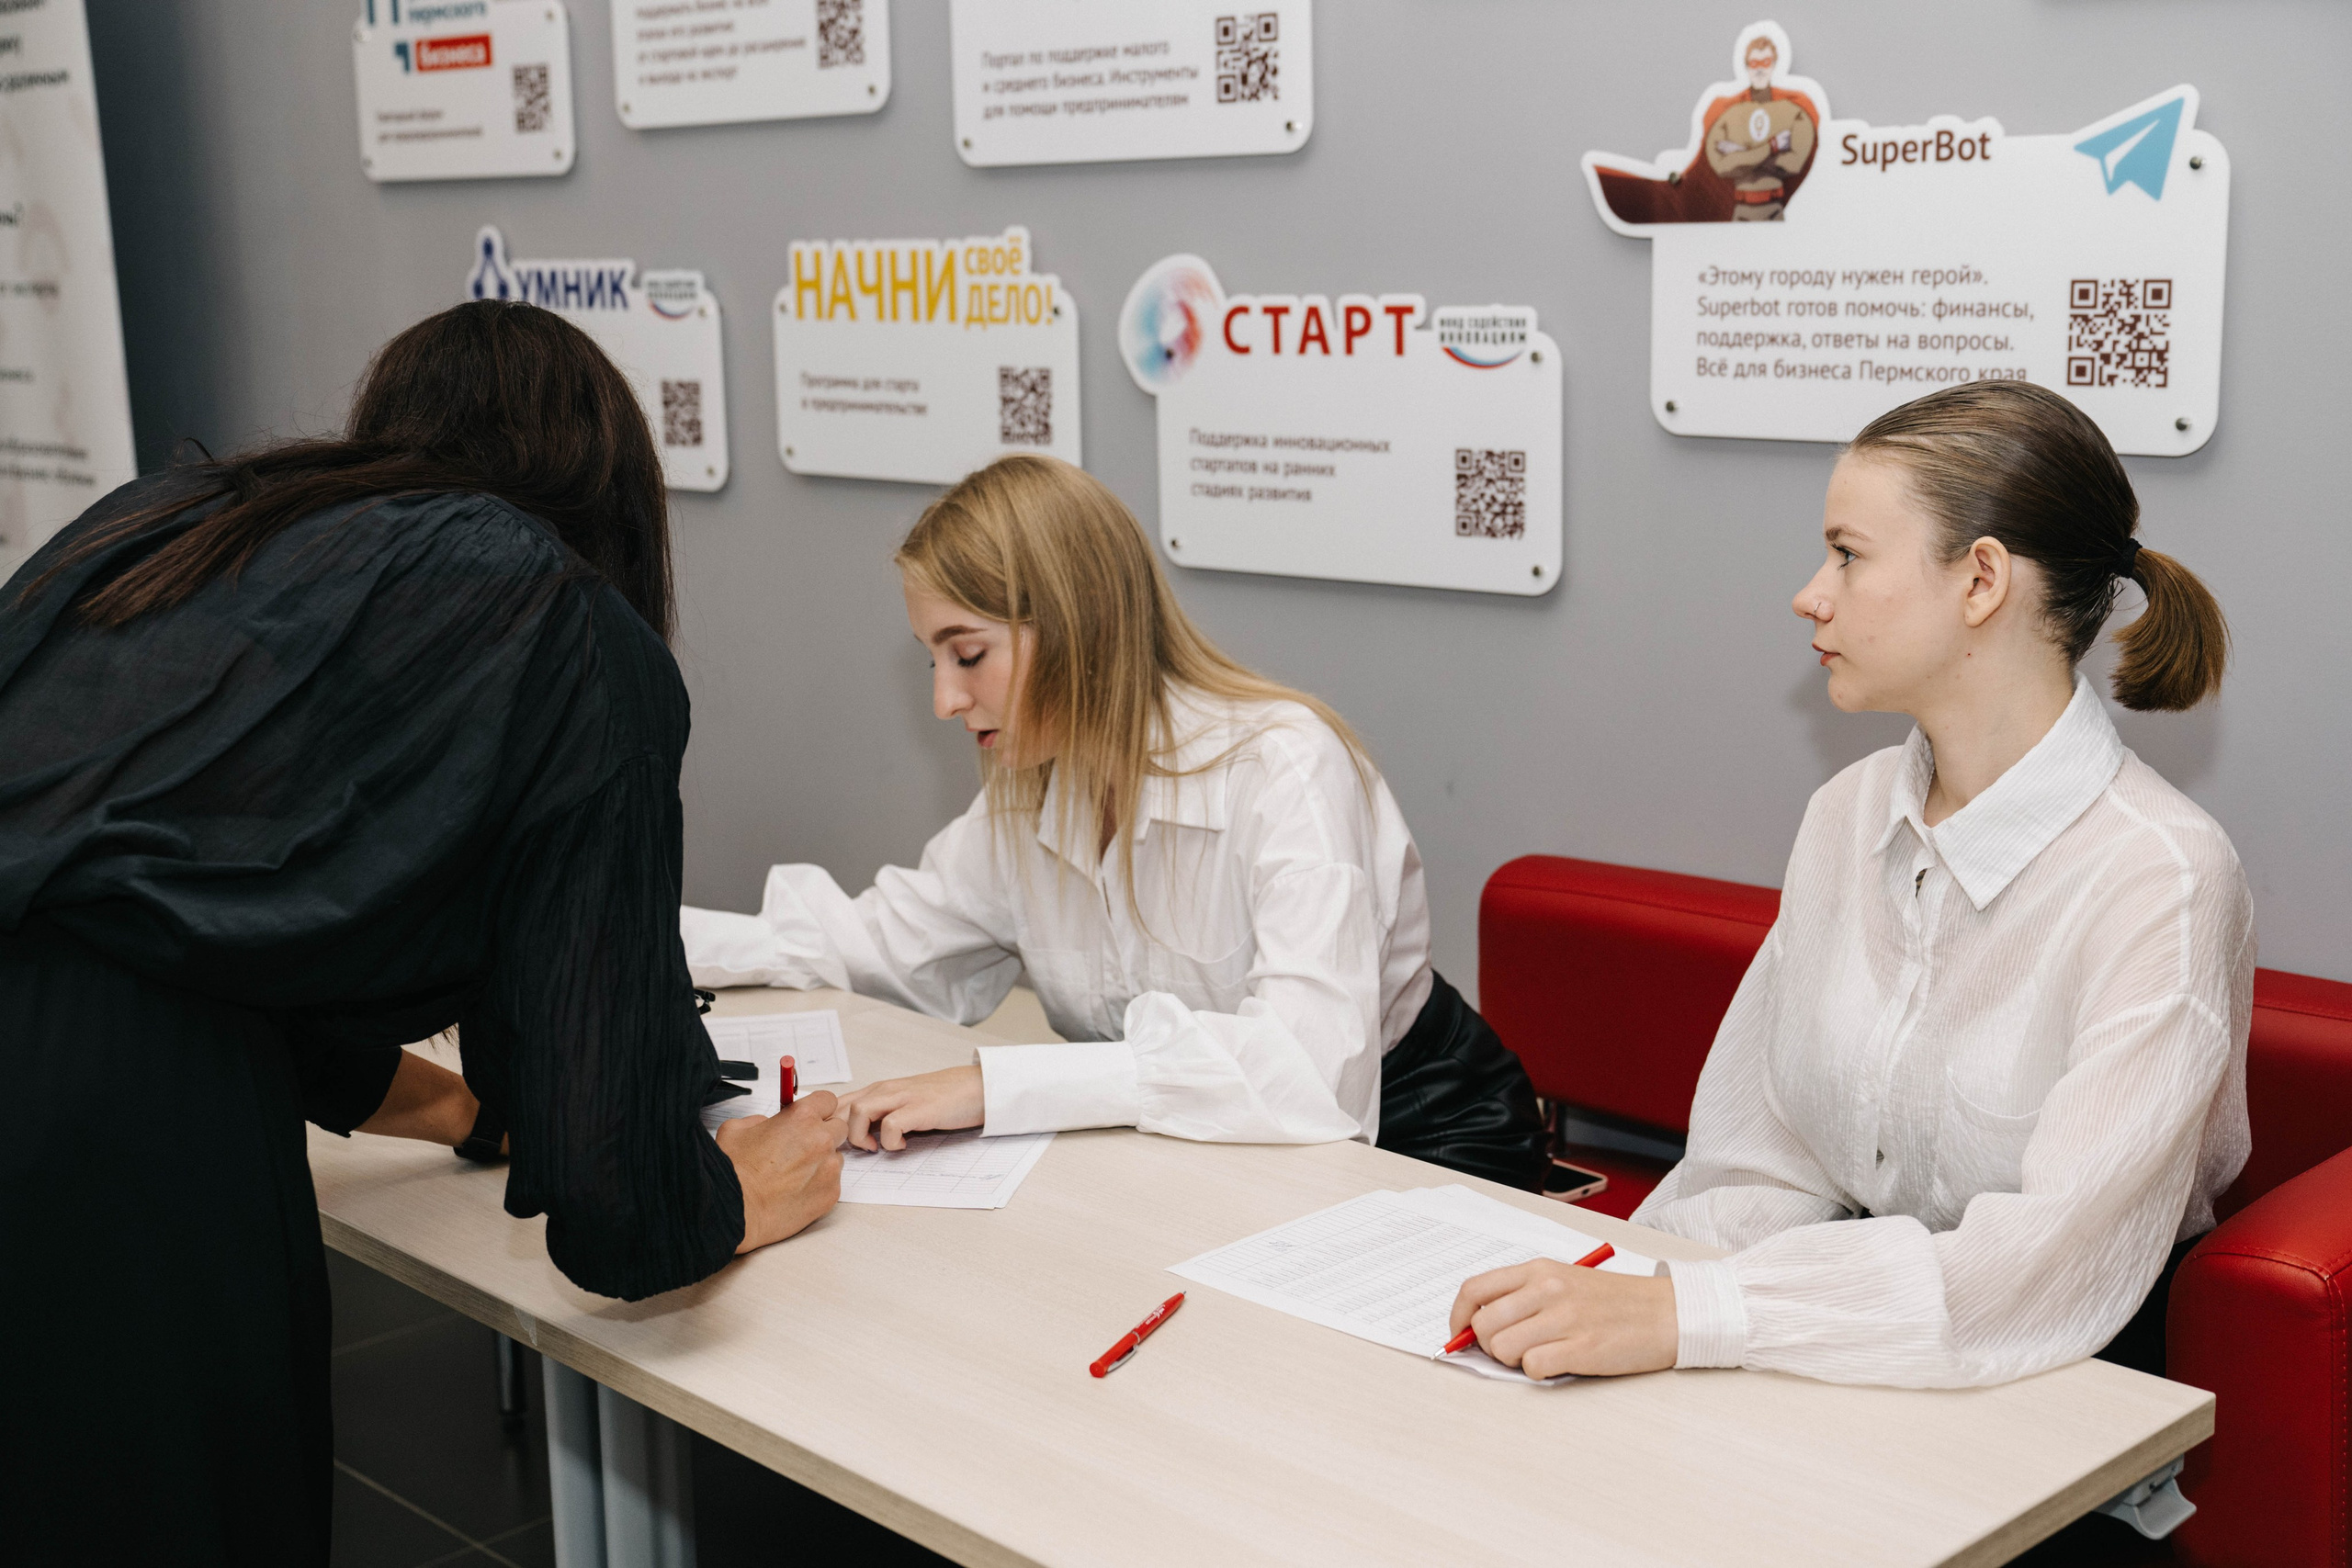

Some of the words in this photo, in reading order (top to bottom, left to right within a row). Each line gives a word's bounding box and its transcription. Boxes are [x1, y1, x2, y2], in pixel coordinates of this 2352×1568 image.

[1030, 51, 1043, 65] по
[1841, 130, 1991, 172] SuperBot
[514, 267, 629, 310] УМНИК
[793, 248, 956, 321] НАЧНИ
[1698, 265, 1763, 290] «Этому
[1770, 267, 1836, 291] городу
[1841, 268, 1905, 288] нужен
[1911, 265, 1989, 288] герой».
[965, 283, 1054, 331] ДЕЛО!
[1697, 296, 1781, 321] Superbot
[1787, 299, 1838, 319] готов
[1845, 299, 1927, 318] помочь:
[1931, 297, 2035, 322] финансы,
[1223, 305, 1415, 355] СТАРТ
[1697, 329, 1807, 353] поддержка,
[1812, 331, 1880, 349] ответы
[1887, 333, 1911, 350] на
[1918, 333, 2016, 354] вопросы.
[1696, 356, 1729, 378] Всё
[1734, 362, 1769, 382] для
[1774, 358, 1852, 380] бизнеса
[1860, 361, 1971, 386] Пермского
[1190, 428, 1268, 448] Поддержка
[1272, 435, 1391, 453] инновационных
[1262, 461, 1279, 475] на
[1284, 461, 1336, 478] ранних
[1248, 486, 1312, 502] развития
